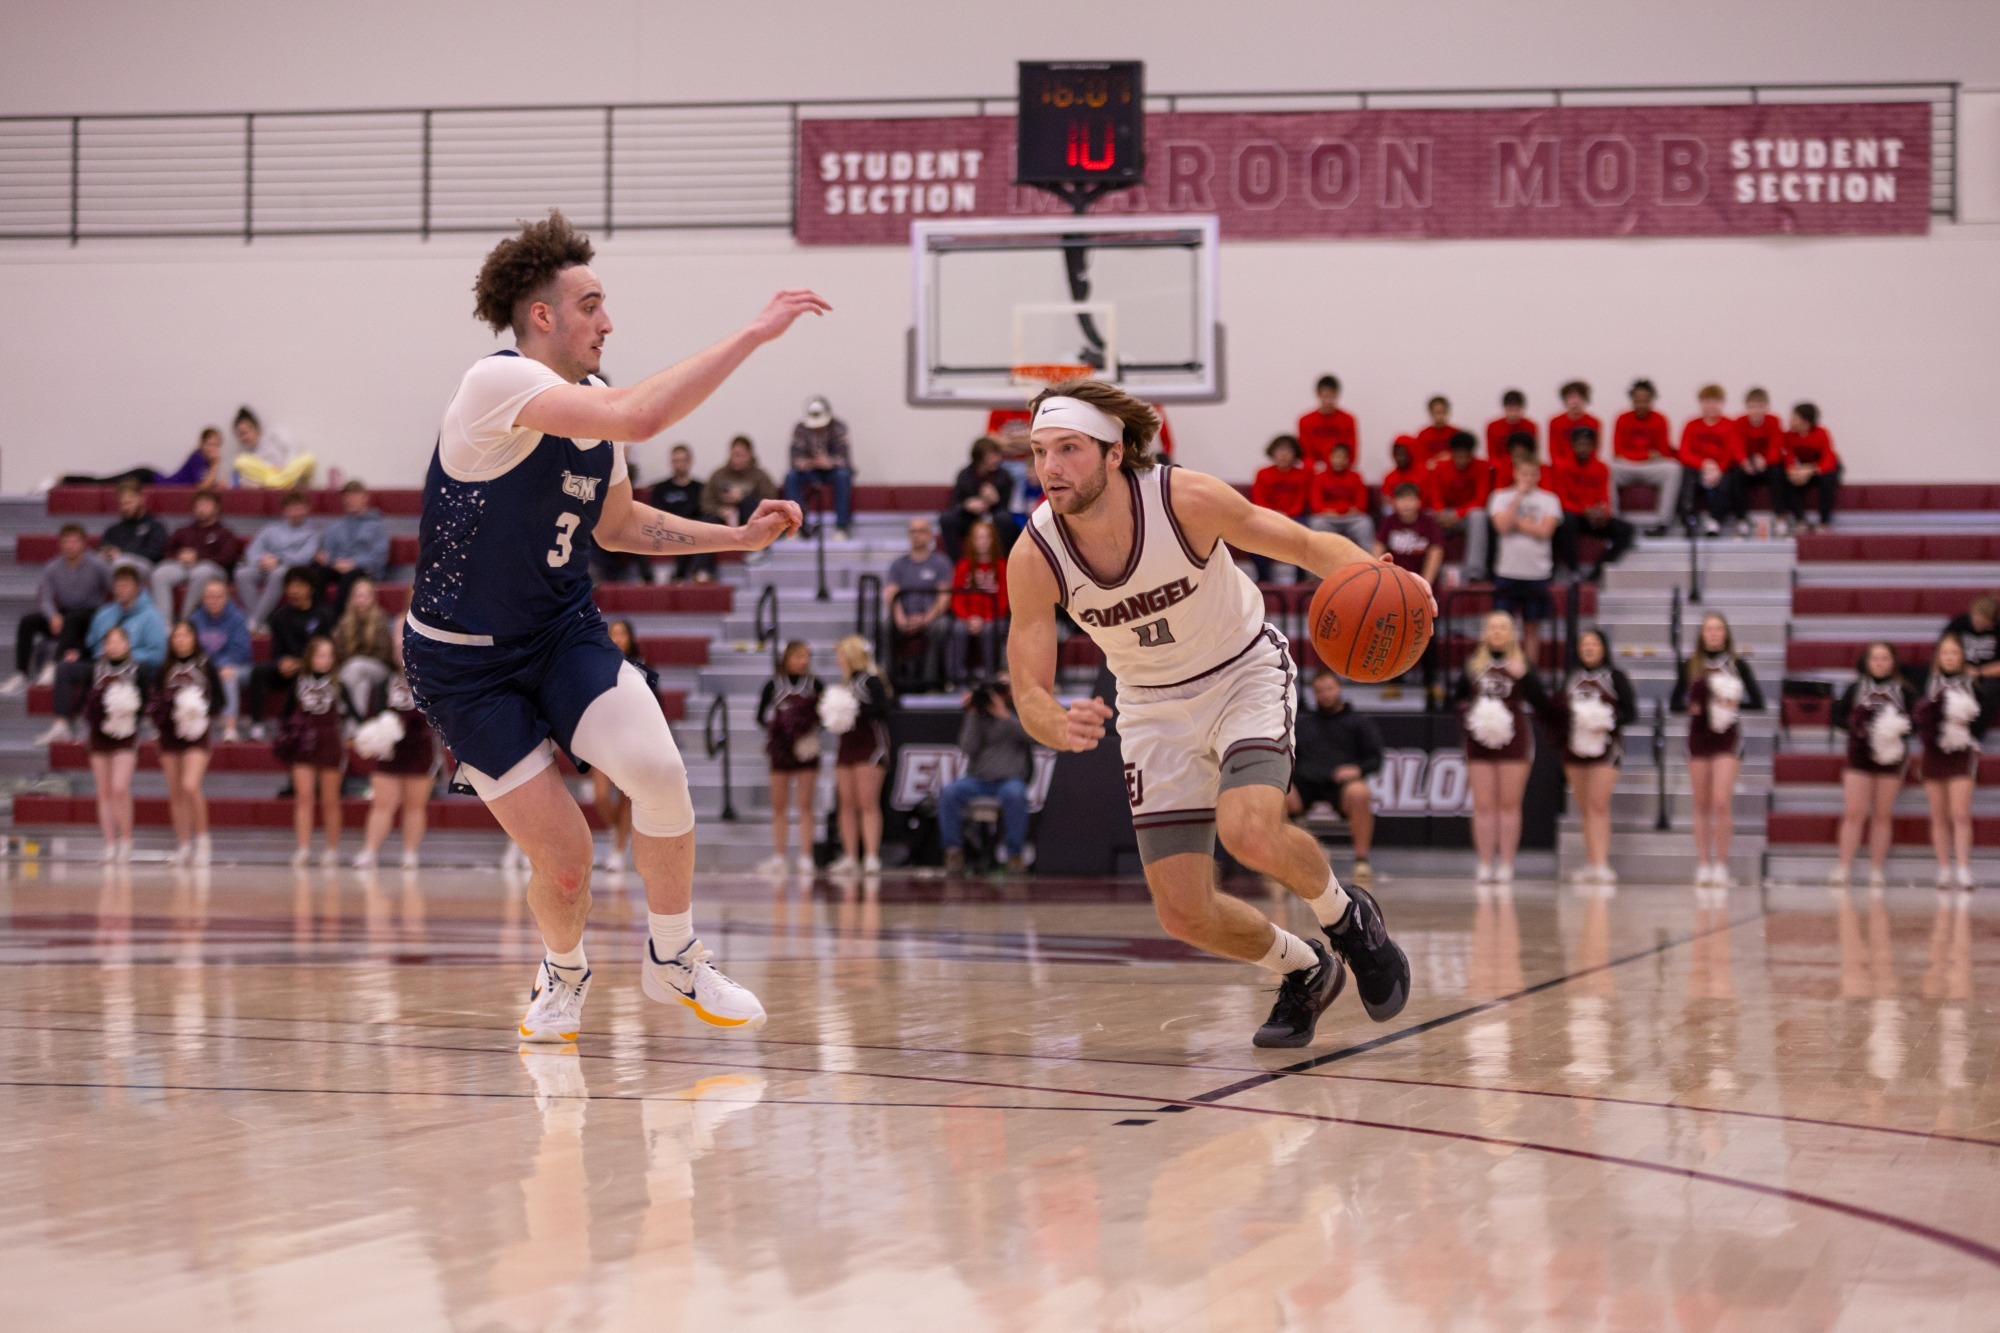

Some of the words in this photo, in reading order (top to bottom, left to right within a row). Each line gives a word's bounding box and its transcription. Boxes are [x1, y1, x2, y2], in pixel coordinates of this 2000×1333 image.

[820, 149, 984, 182] STUDENT
[1494, 136, 1710, 208] MOB
[1729, 139, 1904, 169] STUDENT
[825, 183, 977, 215] SECTION
[1734, 172, 1897, 203] SECTION
[546, 511, 581, 568] 3
[1078, 576, 1199, 628] EVANGEL
[1369, 612, 1398, 675] LEGACY
